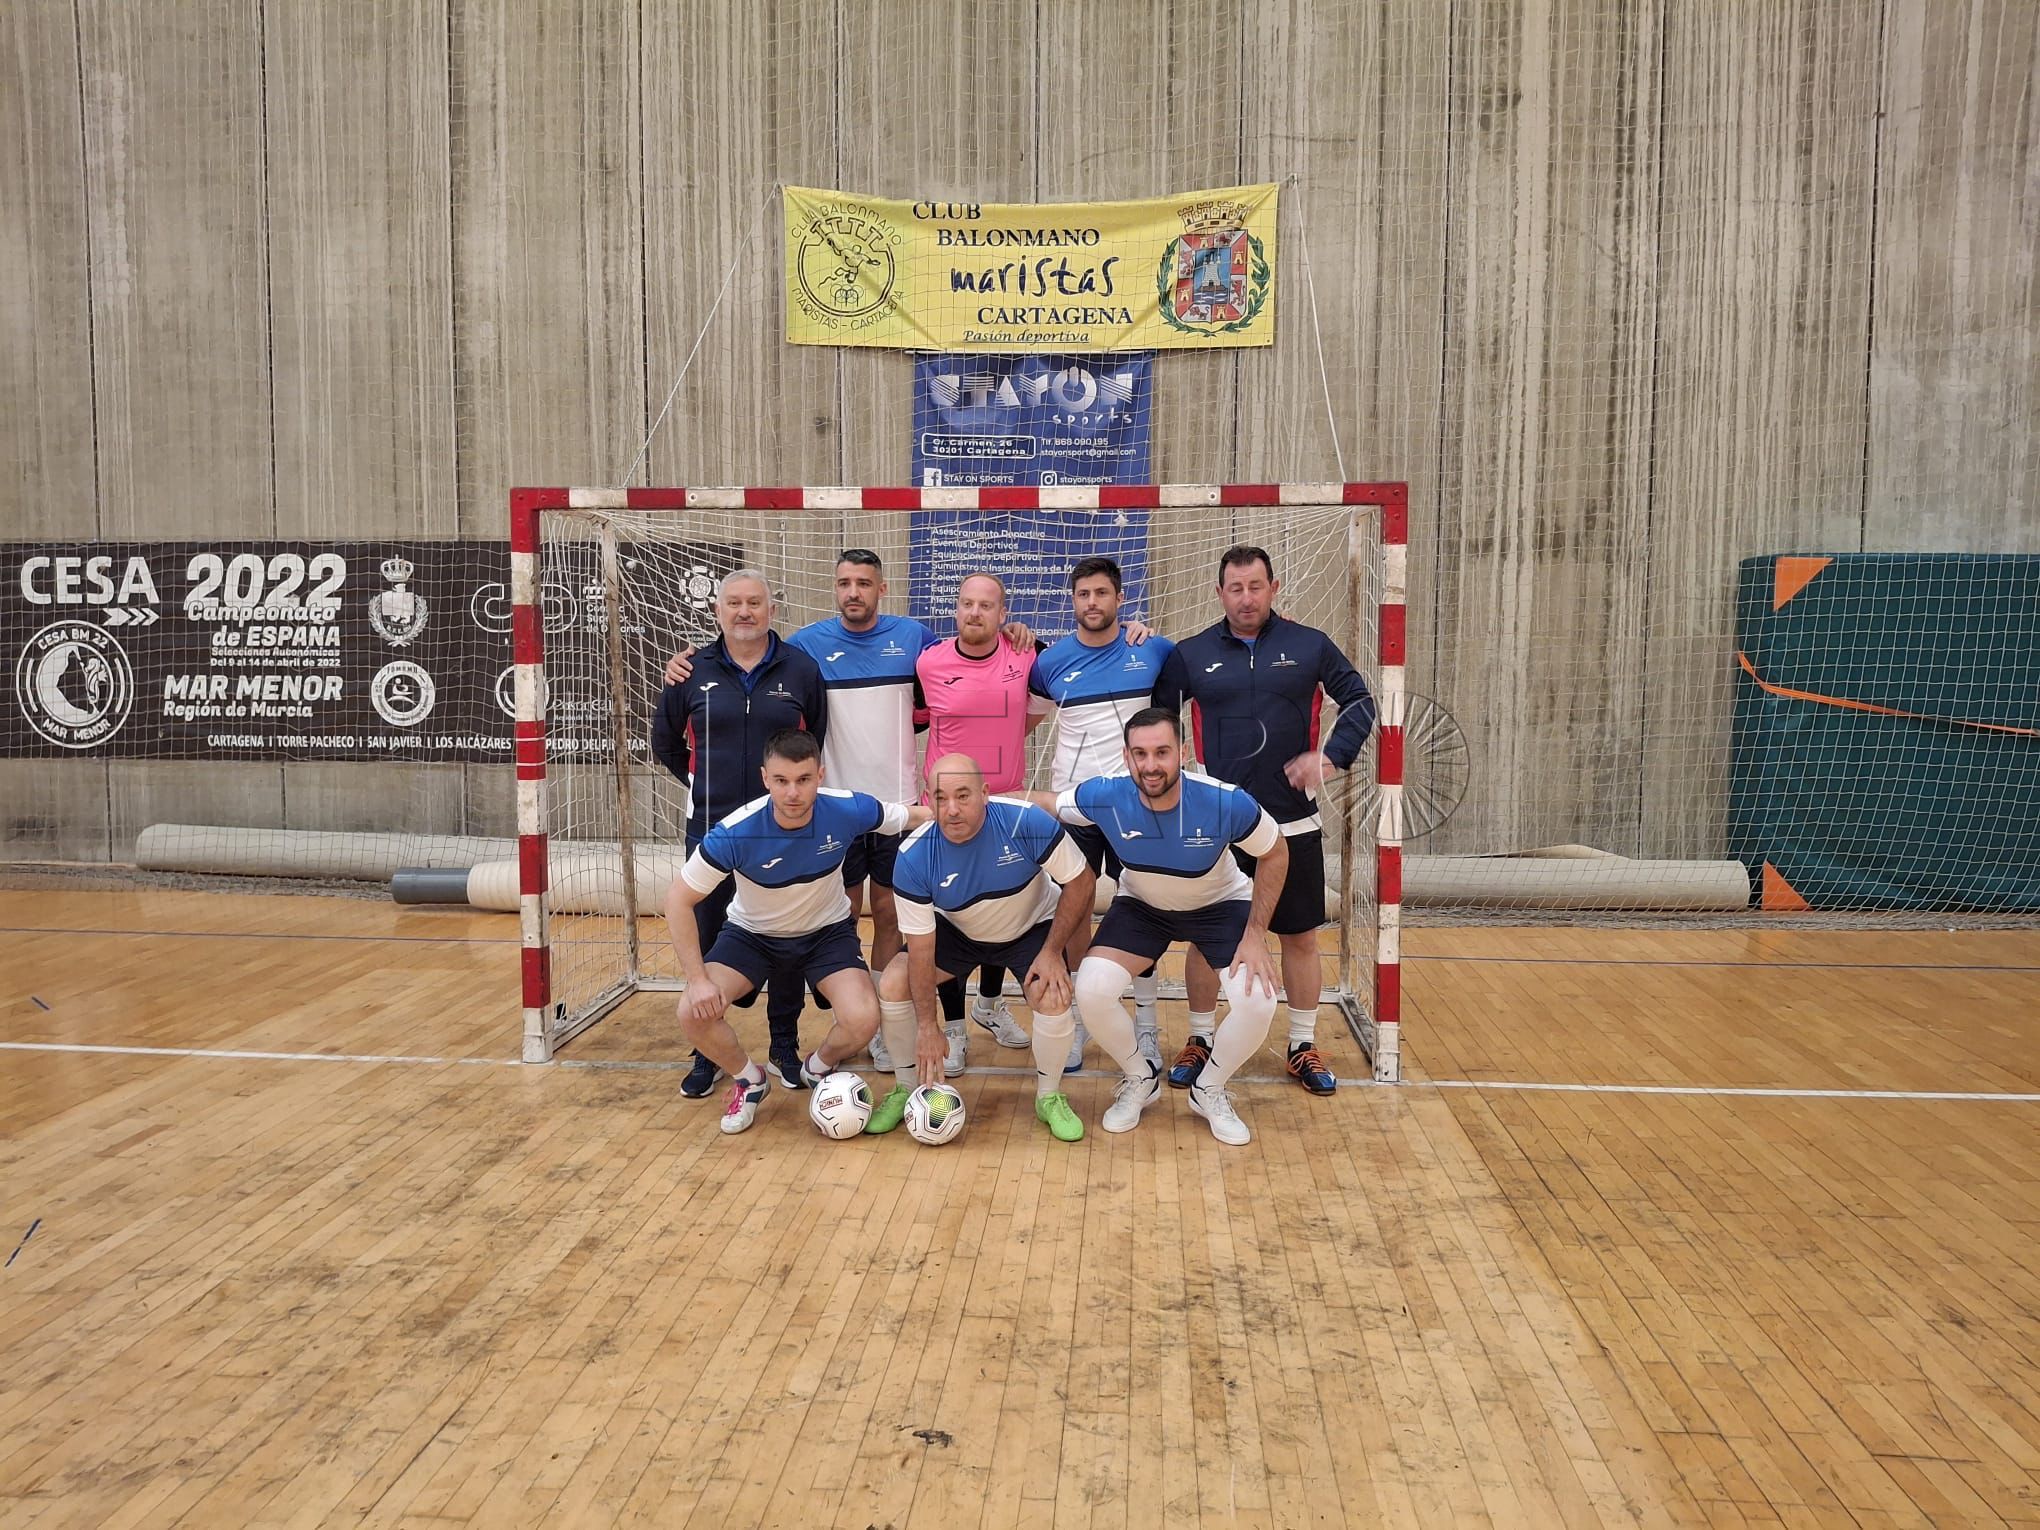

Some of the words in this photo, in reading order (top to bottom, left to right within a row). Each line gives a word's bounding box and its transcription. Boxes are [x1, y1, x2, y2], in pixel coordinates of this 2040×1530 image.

[912, 202, 981, 220] CLUB
[937, 228, 1101, 247] BALONMANO
[950, 255, 1120, 297] maristas
[977, 307, 1134, 325] CARTAGENA
[964, 329, 1012, 342] Pasión
[1017, 329, 1090, 344] deportiva
[966, 447, 1026, 456] Cartagena
[980, 475, 1014, 484] SPORTS
[1060, 475, 1113, 484] stayonsports
[932, 540, 968, 548] Eventos
[969, 540, 1019, 551] Deportivos
[20, 556, 160, 604] CESA
[184, 552, 347, 611] 2022
[187, 600, 336, 628] Campeonato
[37, 629, 69, 650] CESA
[71, 628, 90, 641] BM
[93, 632, 108, 649] 22
[212, 625, 241, 647] de
[211, 646, 270, 657] Selecciones
[210, 657, 227, 667] Del
[237, 657, 246, 667] al
[249, 657, 260, 667] 14
[262, 657, 275, 667] de
[276, 657, 301, 667] abril
[302, 657, 315, 667] de
[317, 658, 341, 667] 2022
[163, 674, 229, 700] MAR
[235, 674, 344, 701] MENOR
[163, 700, 221, 721] Región
[225, 701, 247, 717] de
[250, 701, 314, 717] Murcia
[42, 718, 68, 739] MAR
[73, 718, 111, 741] MENOR
[207, 734, 264, 747] CARTAGENA
[276, 735, 308, 748] TORRE
[310, 735, 355, 748] PACHECO
[367, 736, 387, 748] SAN
[389, 736, 422, 750] JAVIER
[435, 736, 453, 748] LOS
[456, 734, 512, 750] ALCÁZARES
[545, 738, 579, 751] PEDRO
